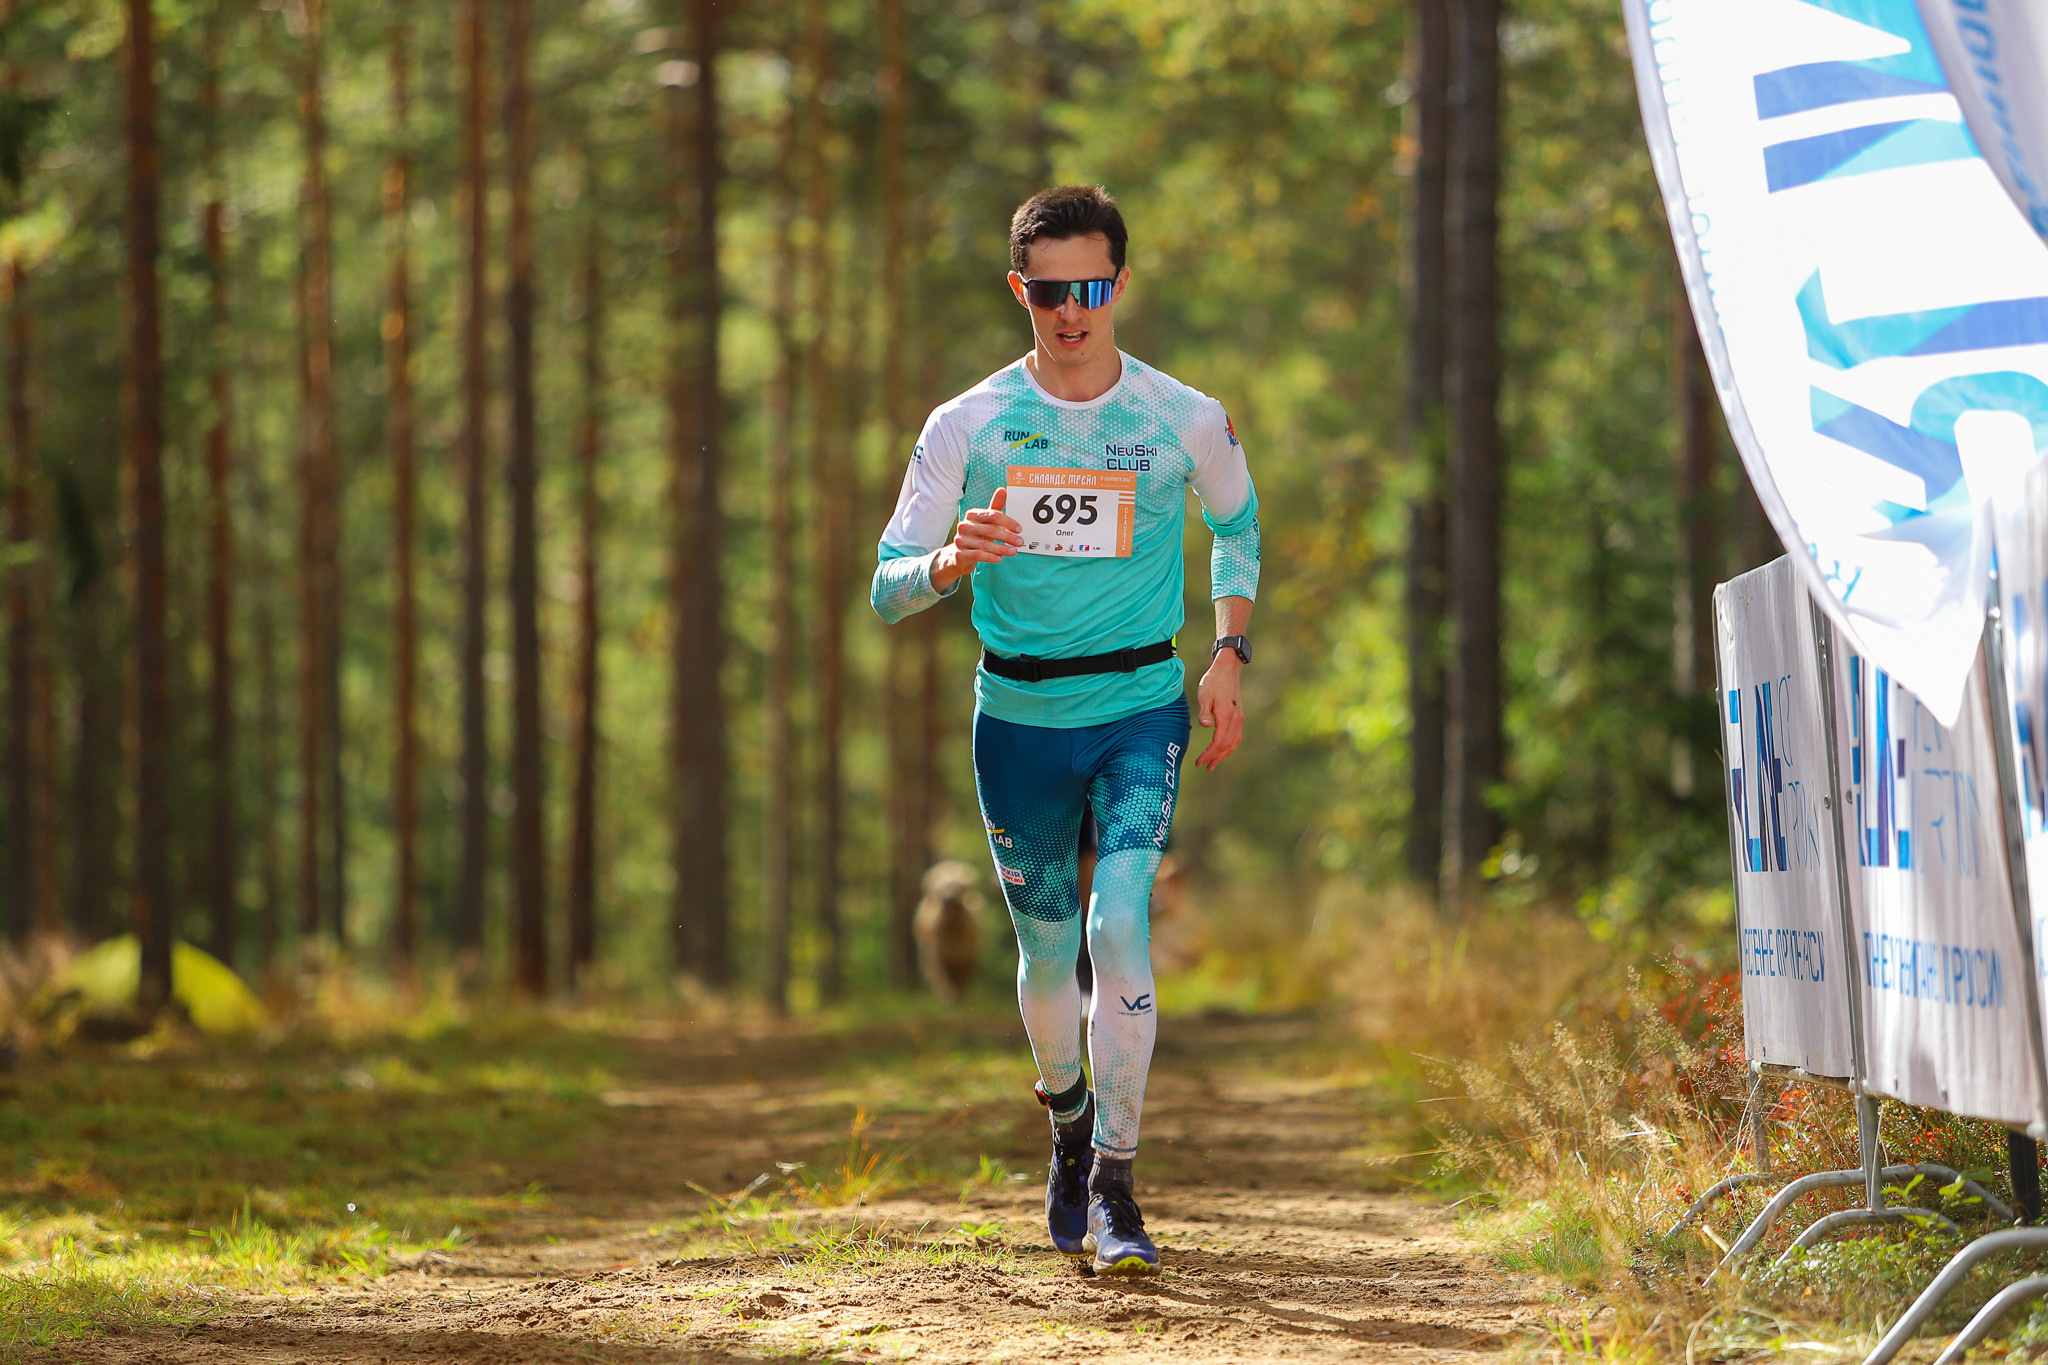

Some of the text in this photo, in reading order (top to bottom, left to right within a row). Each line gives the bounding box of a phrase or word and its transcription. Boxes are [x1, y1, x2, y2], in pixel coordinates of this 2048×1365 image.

[1004, 431, 1030, 441] RUN
[1025, 439, 1049, 449] LAB
[1106, 458, 1151, 472] CLUB
[1032, 494, 1098, 525] 695
[1121, 507, 1129, 551] CLASSIC
[1165, 741, 1181, 788] CLUB
